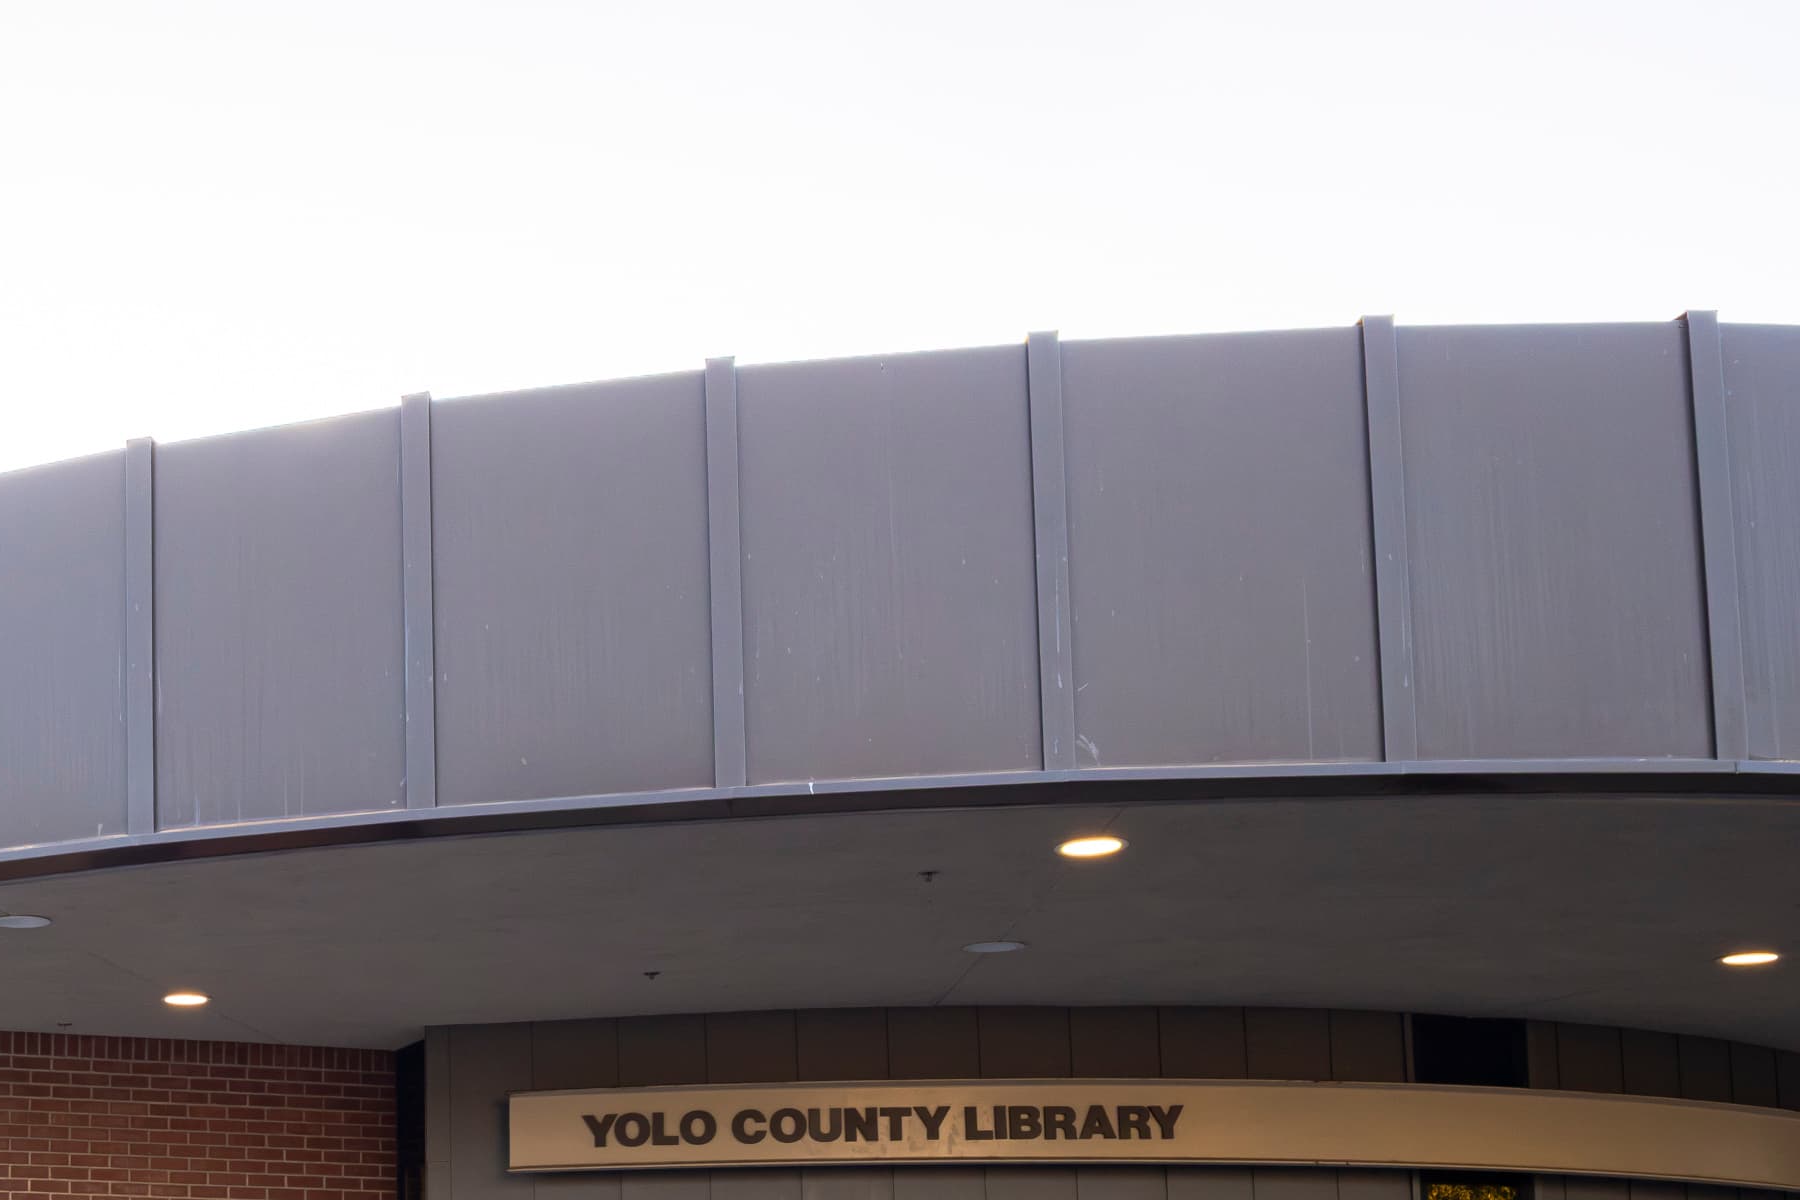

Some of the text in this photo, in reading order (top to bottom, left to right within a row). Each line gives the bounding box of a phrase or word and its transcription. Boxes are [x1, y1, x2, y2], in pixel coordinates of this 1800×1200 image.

[582, 1104, 1185, 1148] YOLO COUNTY LIBRARY
